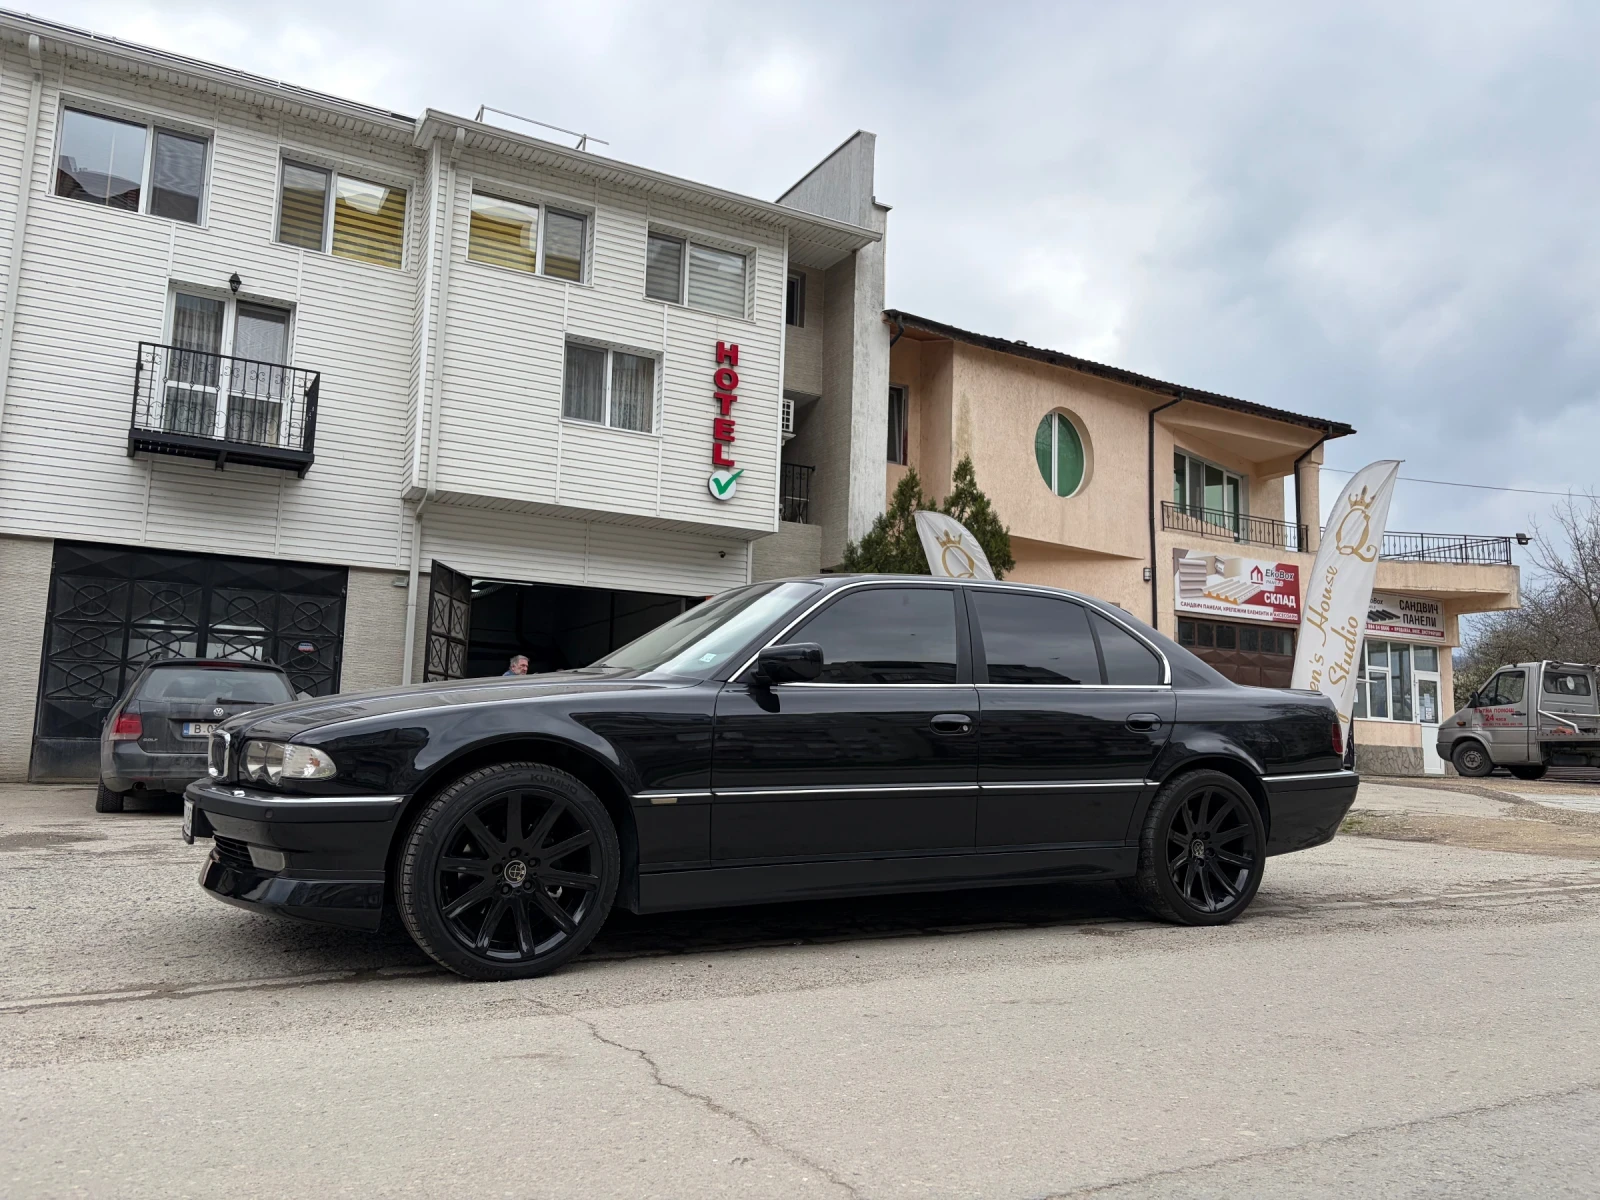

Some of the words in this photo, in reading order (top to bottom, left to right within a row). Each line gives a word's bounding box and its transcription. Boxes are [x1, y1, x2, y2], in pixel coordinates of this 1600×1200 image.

[712, 341, 739, 467] HOTEL
[1265, 568, 1294, 580] EkoBox
[1180, 601, 1202, 609] САНДВИЧ
[1264, 592, 1296, 608] СКЛАД
[1306, 565, 1338, 647] House
[1370, 597, 1383, 605] oBox
[1399, 599, 1439, 614] САНДВИЧ
[1402, 613, 1437, 627] ПАНЕЛИ
[1328, 615, 1359, 697] Studio
[1485, 714, 1494, 722] 24
[530, 773, 579, 795] KUMHO
